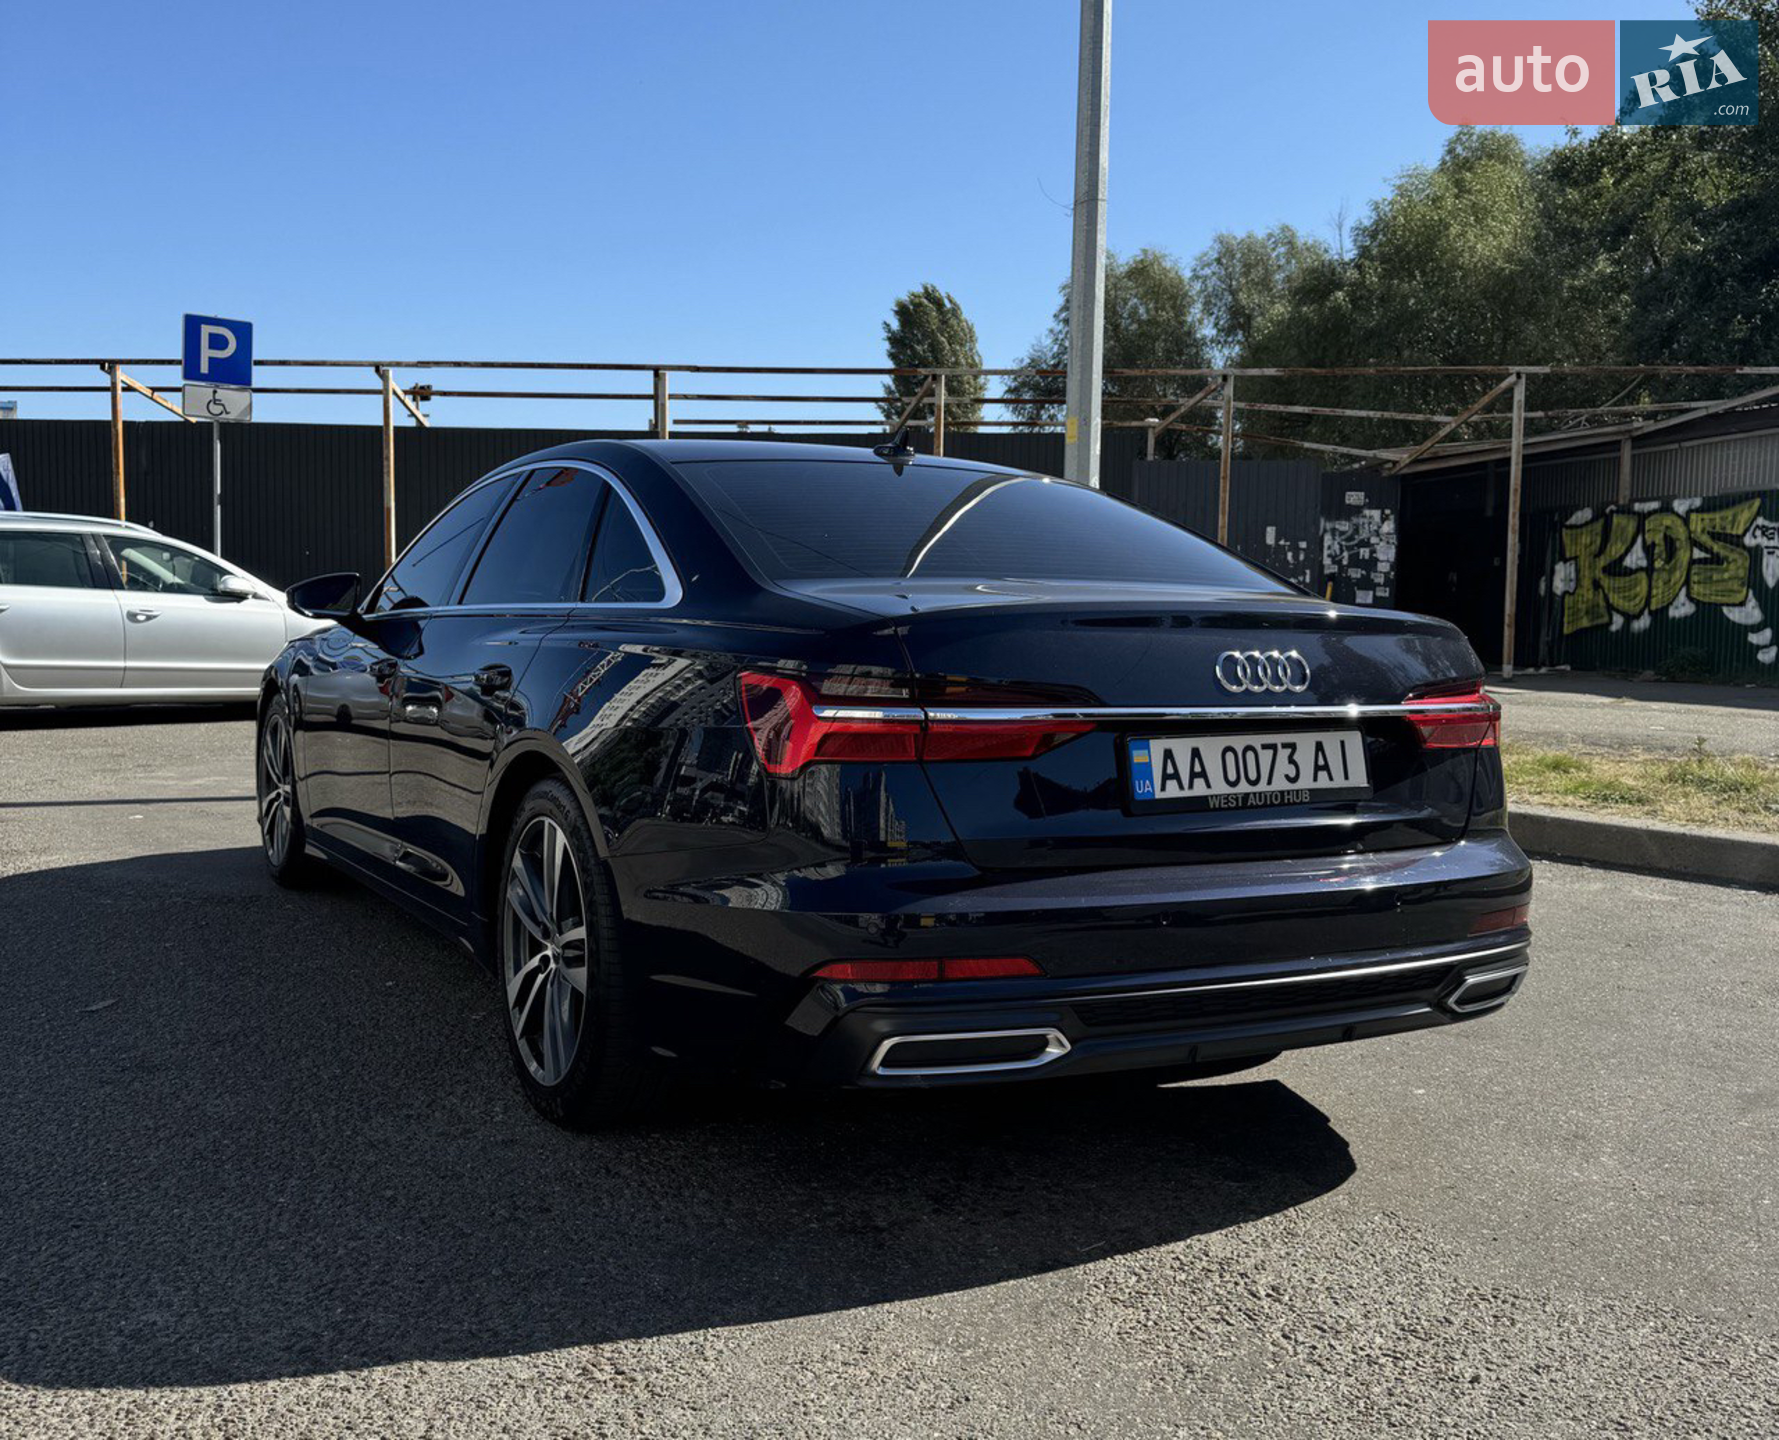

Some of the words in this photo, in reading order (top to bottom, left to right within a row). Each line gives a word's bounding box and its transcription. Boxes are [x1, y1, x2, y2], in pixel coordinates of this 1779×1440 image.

[200, 324, 237, 374] P
[1751, 524, 1779, 541] CRE
[1160, 746, 1212, 792] AA
[1221, 741, 1301, 788] 0073
[1312, 739, 1350, 782] AI
[1135, 779, 1154, 793] UA
[1208, 793, 1245, 809] WEST
[1247, 790, 1281, 806] AUTO
[1283, 789, 1310, 804] HUB
